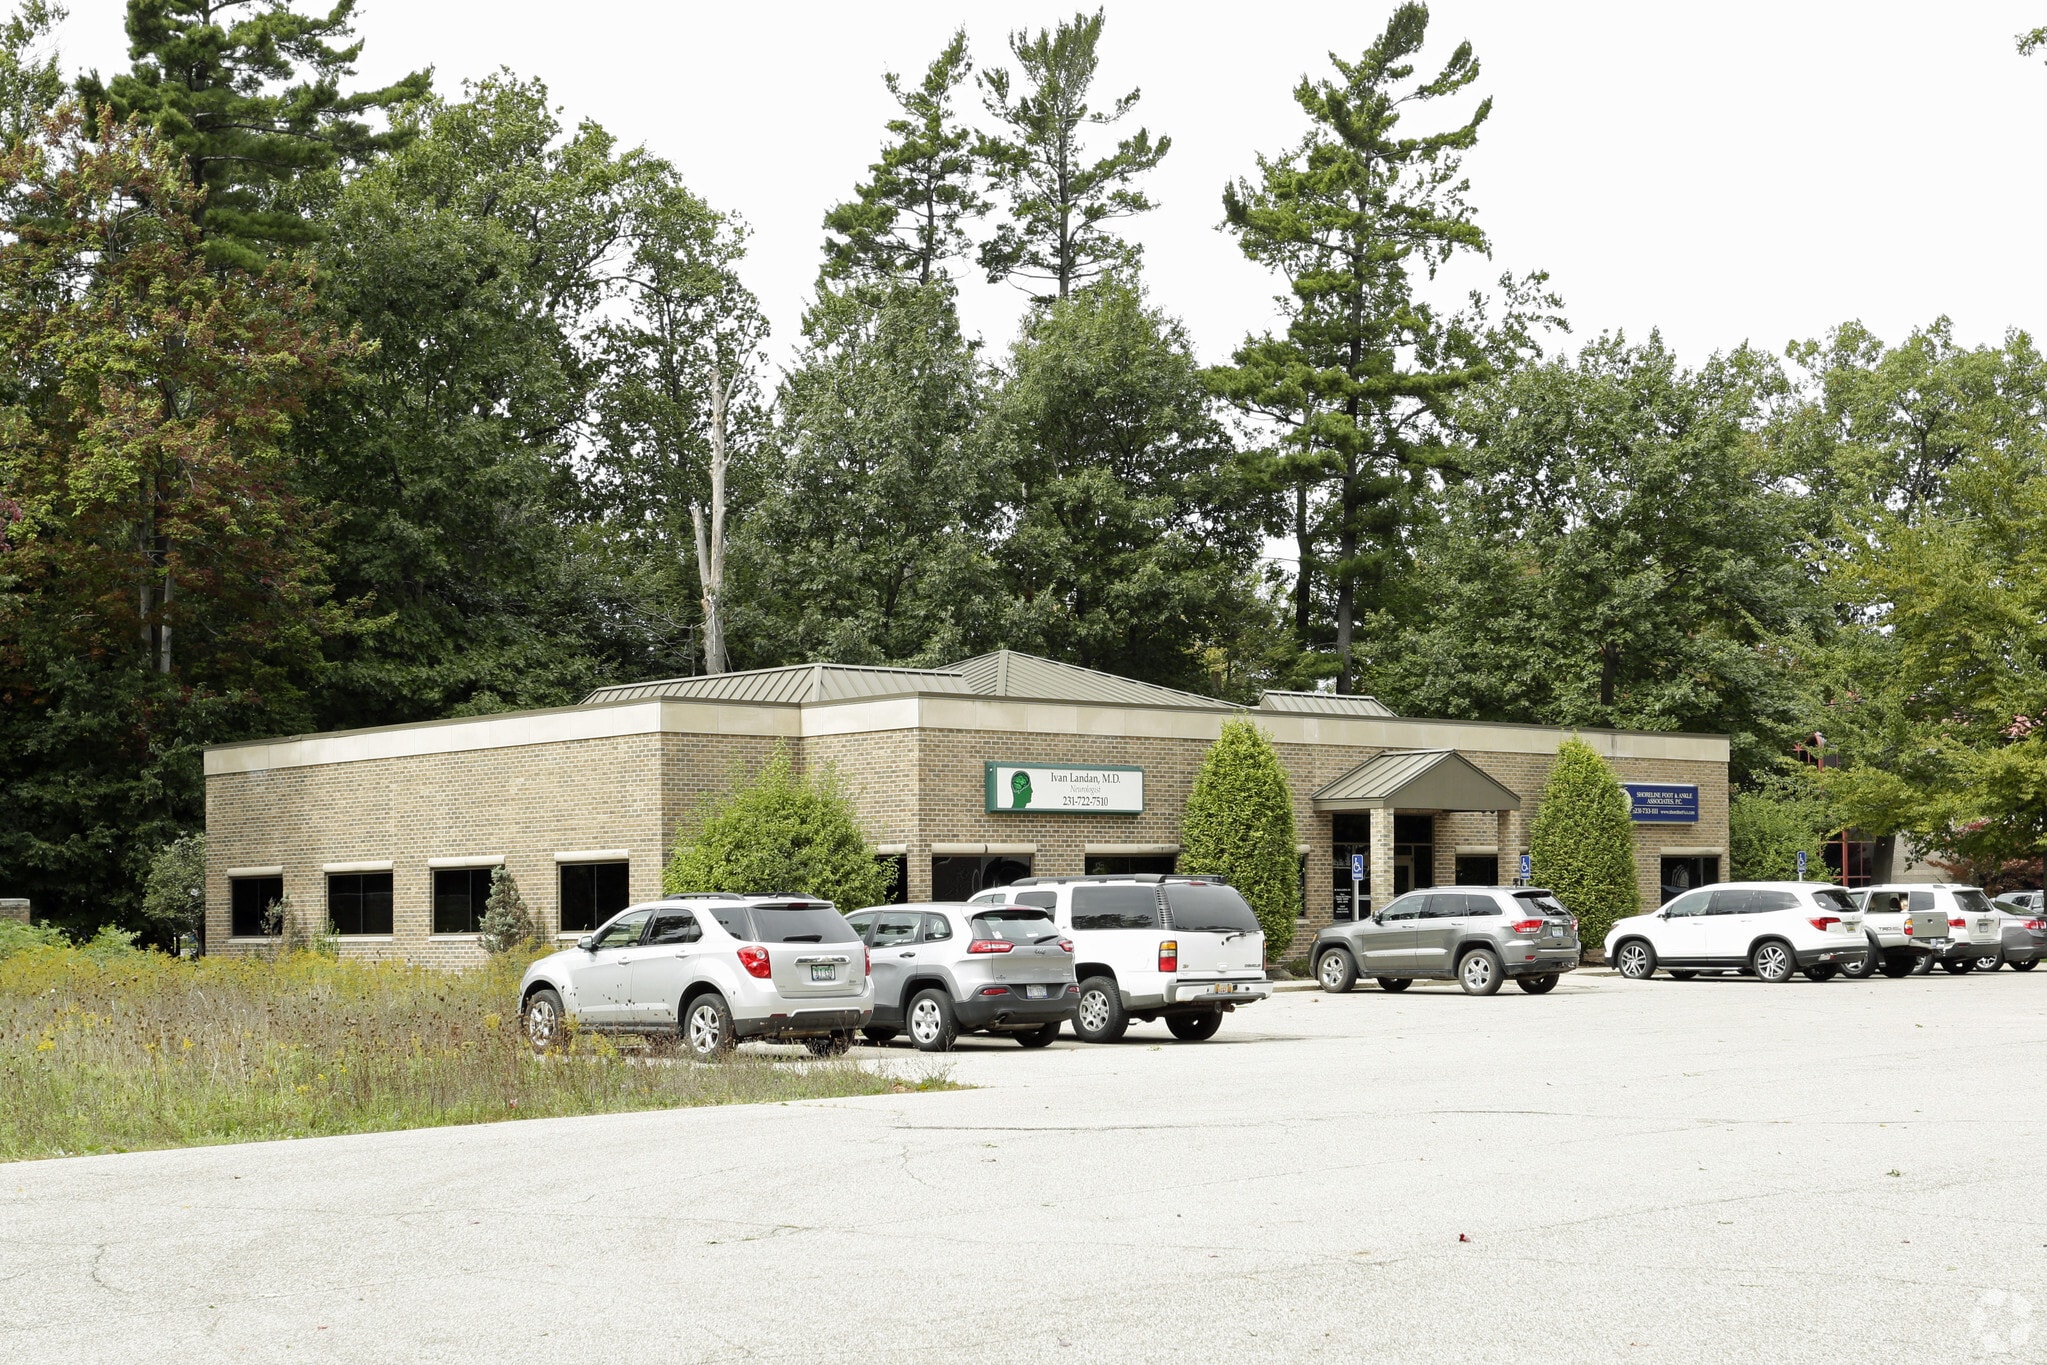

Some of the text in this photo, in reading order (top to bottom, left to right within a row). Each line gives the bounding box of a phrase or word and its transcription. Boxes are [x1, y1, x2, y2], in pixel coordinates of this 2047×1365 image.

[1051, 772, 1121, 784] Ivan Landan, M.D.
[1070, 785, 1101, 795] Neurologist
[1063, 796, 1108, 806] 231-722-7510
